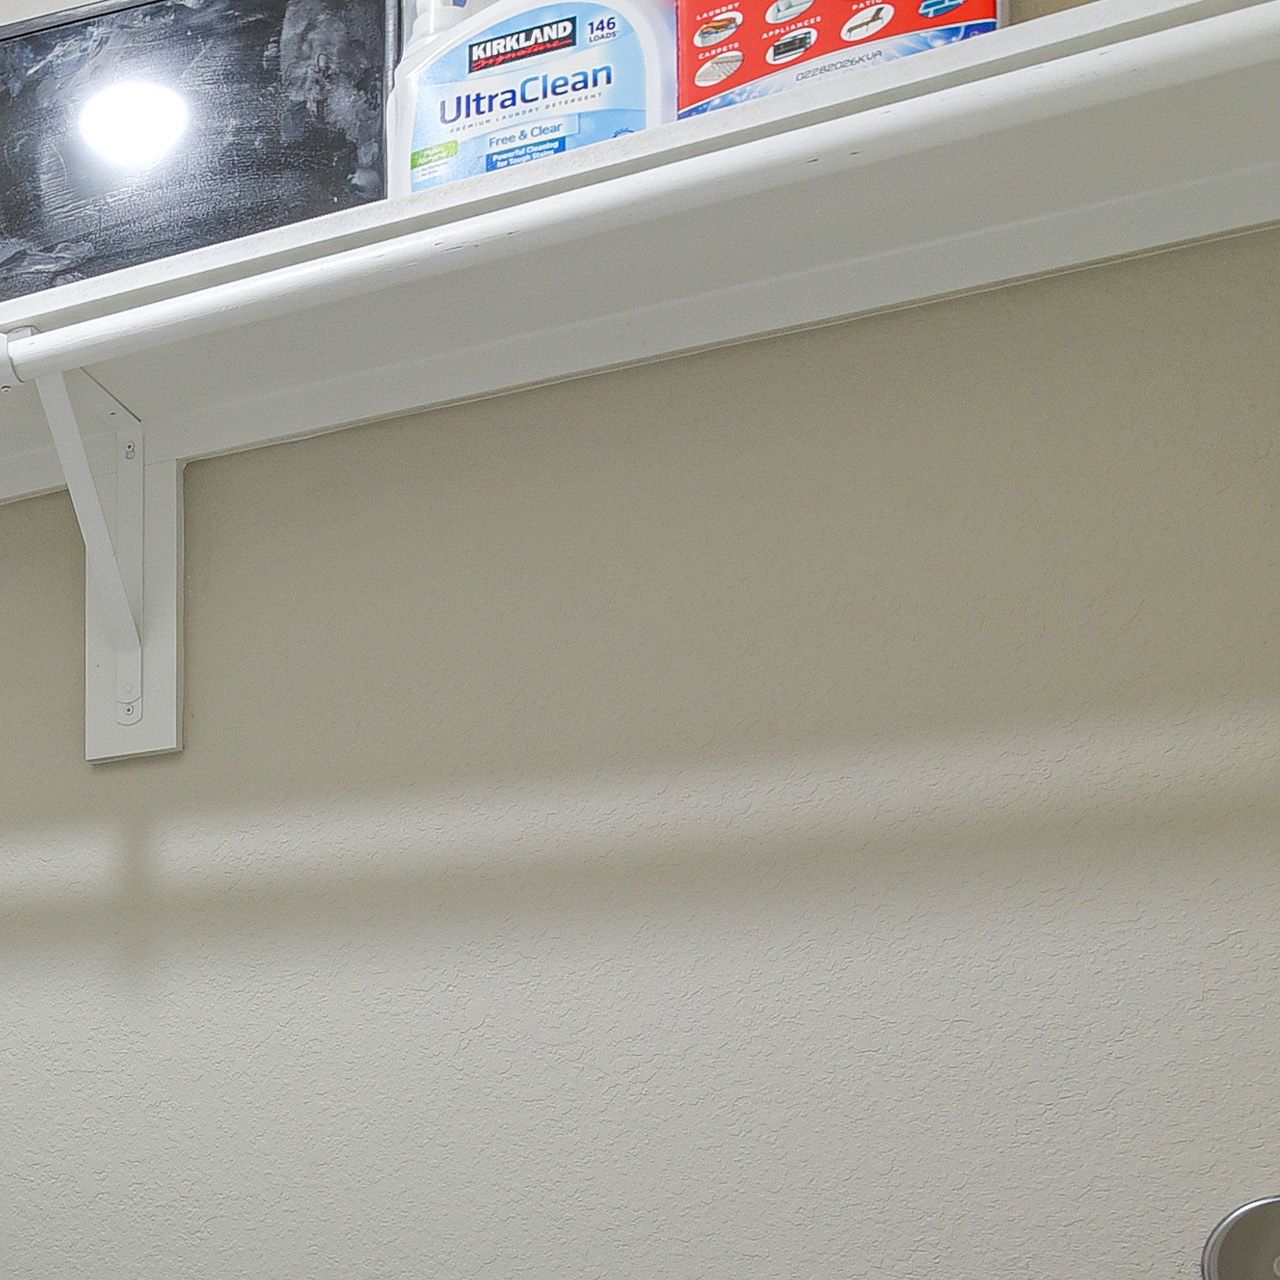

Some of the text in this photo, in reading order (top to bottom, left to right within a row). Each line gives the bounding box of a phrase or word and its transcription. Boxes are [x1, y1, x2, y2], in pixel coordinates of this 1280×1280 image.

[695, 2, 741, 21] LAUNDRY
[587, 16, 617, 35] 146
[588, 31, 618, 43] LOADS
[761, 15, 823, 39] APPLIANCES
[471, 20, 574, 61] KIRKLAND
[697, 41, 741, 60] CARPETS
[439, 64, 612, 125] UltraClean
[449, 91, 604, 133] PREMIUM LAUNDRY DETERGENT
[488, 120, 565, 149] Free & Clear
[492, 140, 560, 163] Powerful Cleaning
